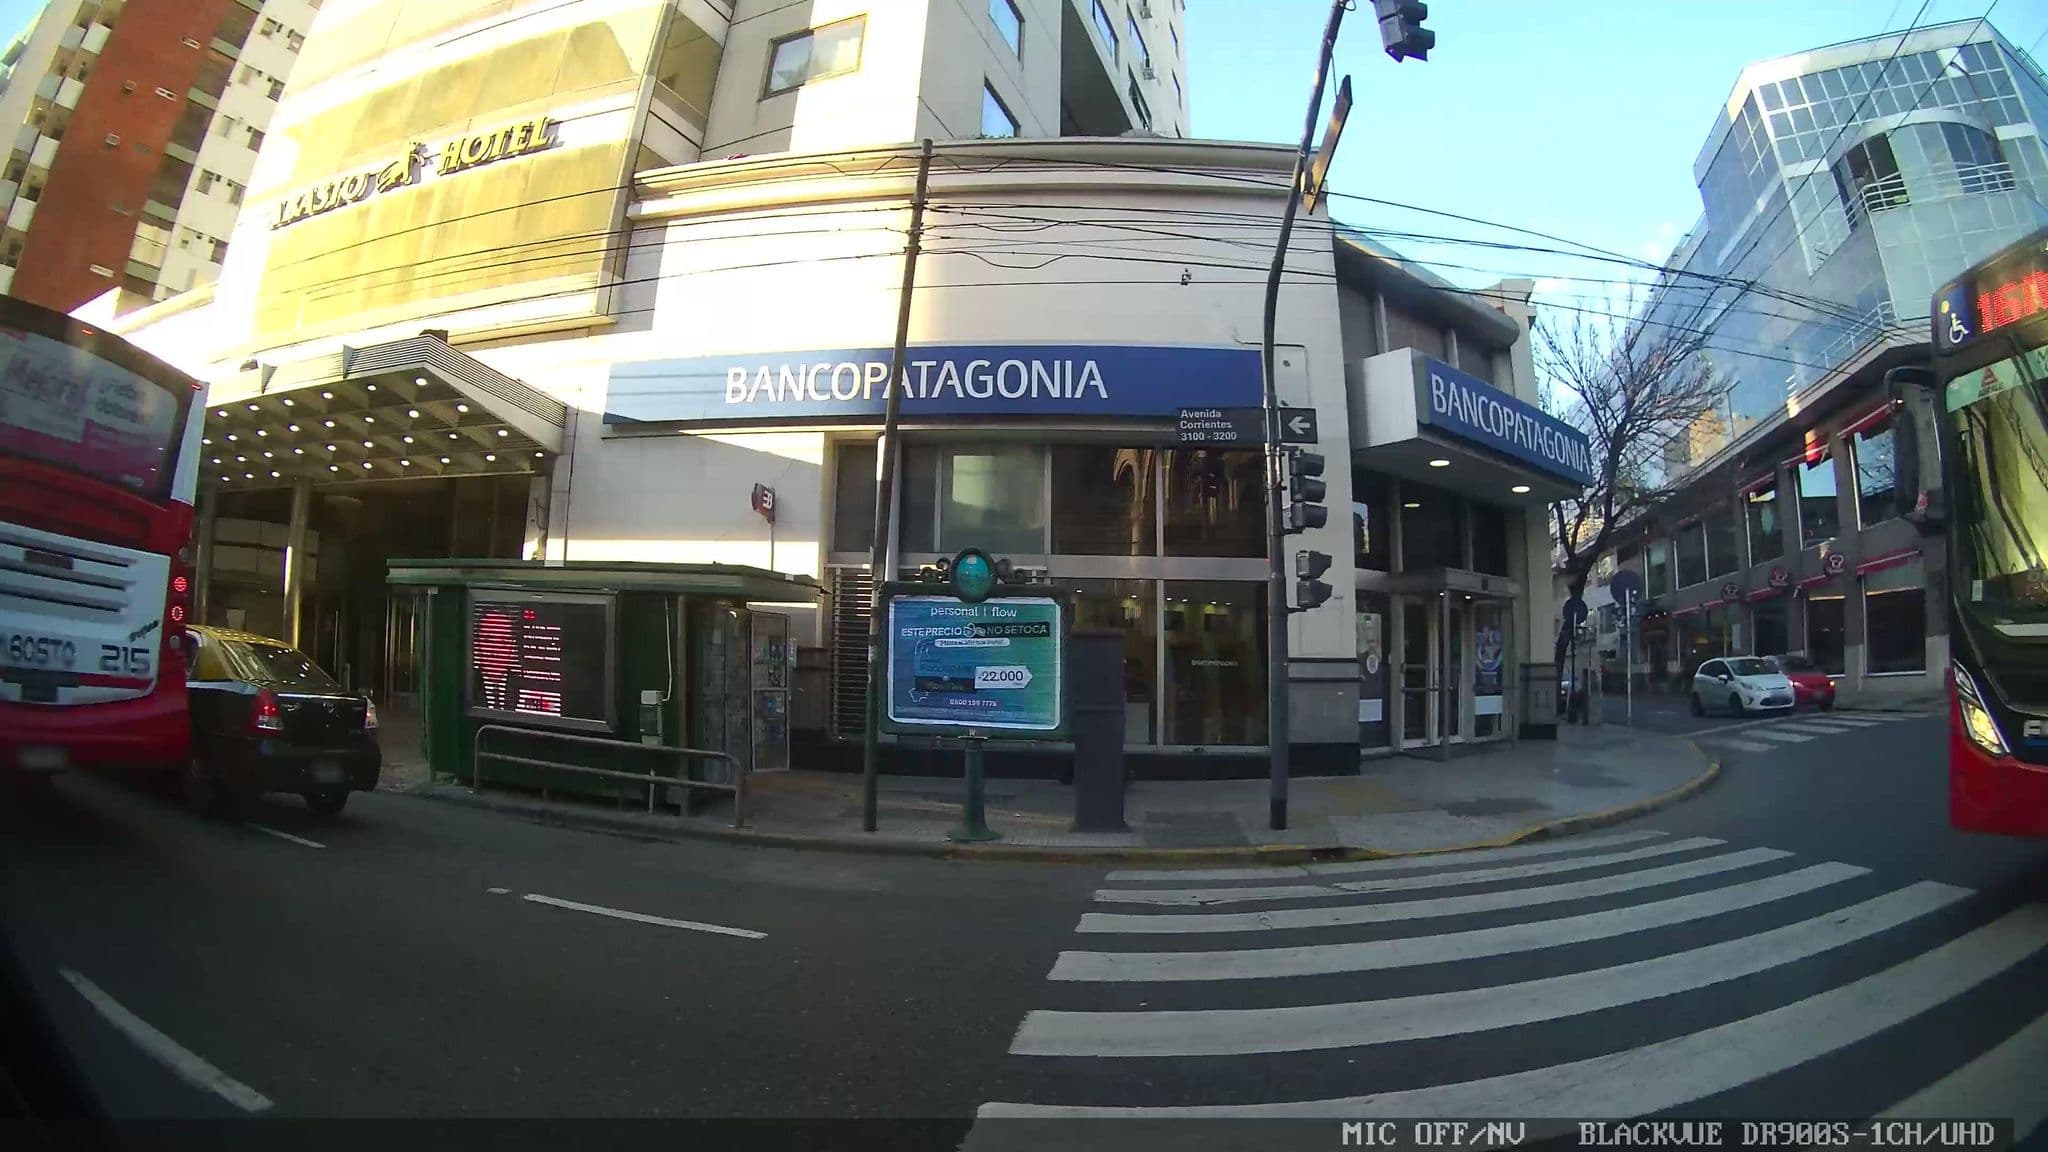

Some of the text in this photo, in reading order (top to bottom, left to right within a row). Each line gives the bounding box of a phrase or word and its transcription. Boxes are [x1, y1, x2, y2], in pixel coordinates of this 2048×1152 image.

[438, 116, 556, 176] HOTEL
[725, 359, 1109, 404] BANCOPATAGONIA
[1180, 409, 1221, 418] Avenida
[1180, 420, 1232, 429] Corrientes
[1431, 373, 1591, 475] BANCOPATAGONIA
[1180, 433, 1204, 441] 3100
[1214, 432, 1237, 441] 3200
[930, 606, 1017, 617] personal flow
[901, 627, 924, 637] ESTE
[925, 626, 962, 636] PRECIO
[1018, 624, 1048, 634] TOCA
[101, 644, 150, 673] 215
